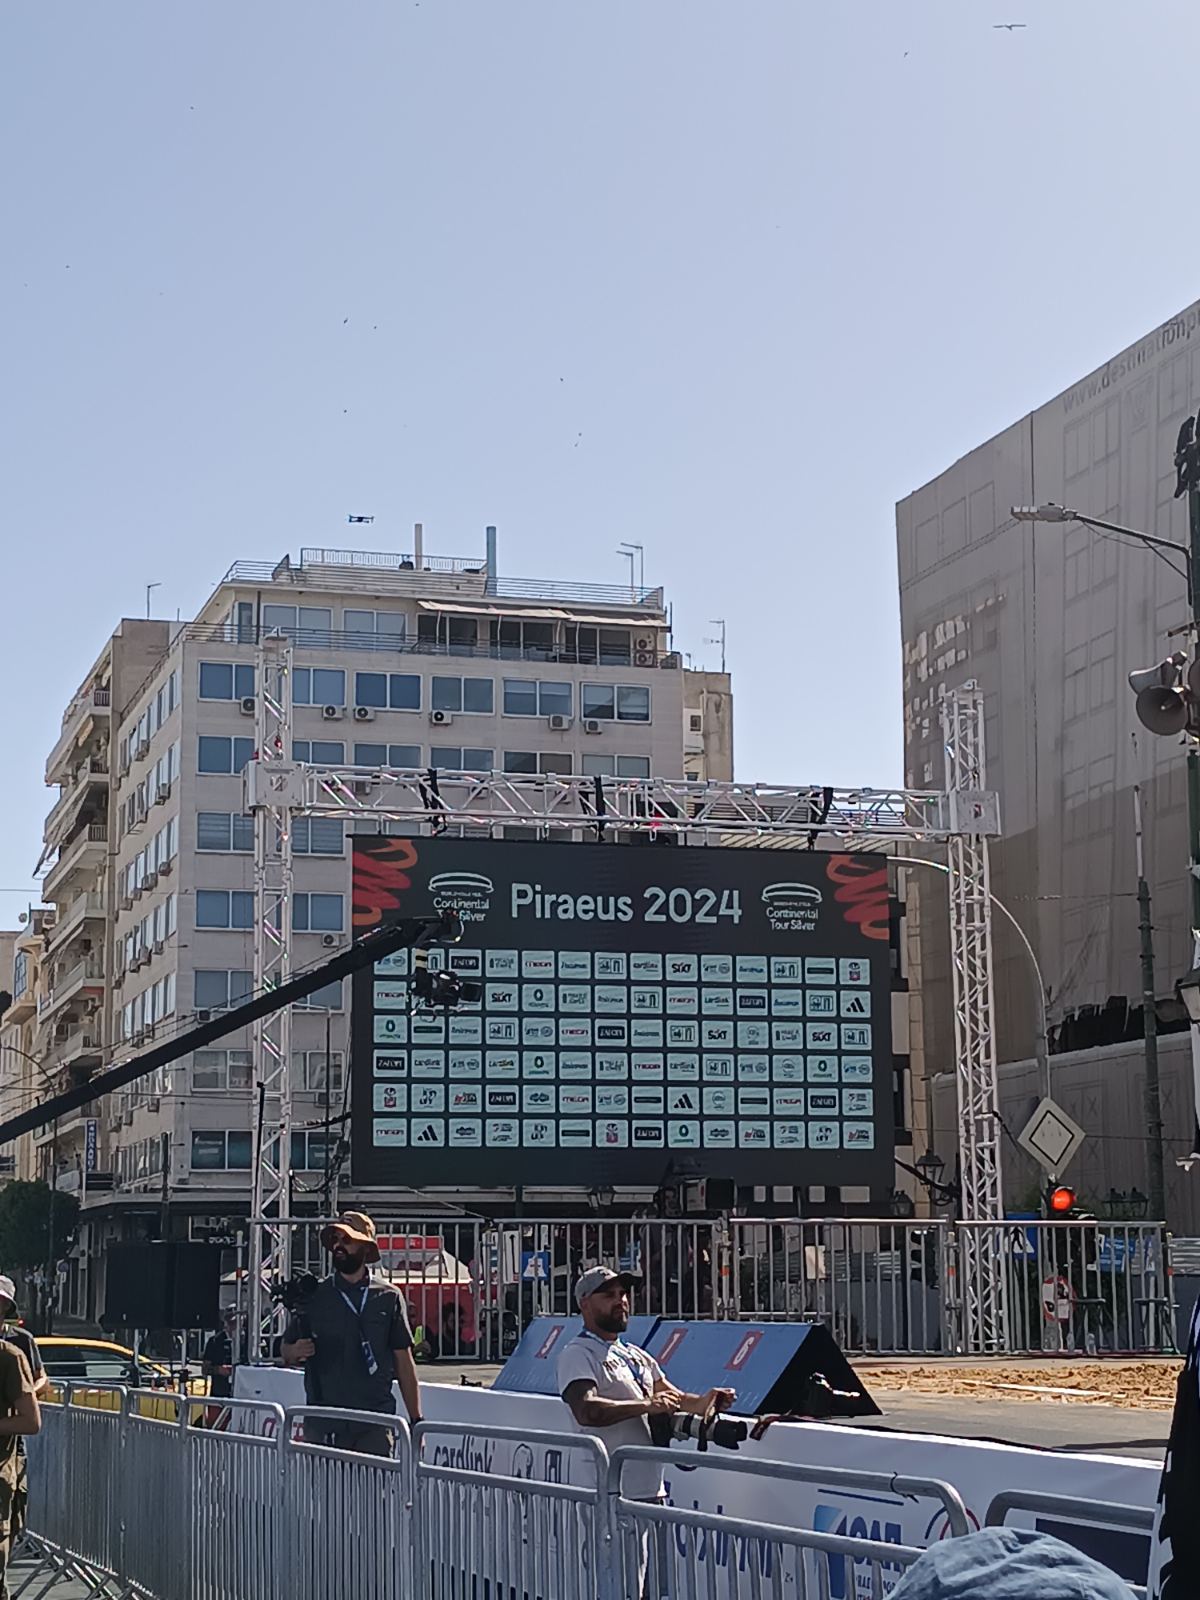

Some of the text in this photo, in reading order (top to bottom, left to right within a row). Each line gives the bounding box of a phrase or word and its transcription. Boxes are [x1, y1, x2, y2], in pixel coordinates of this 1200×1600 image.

[433, 897, 490, 909] Continental
[511, 882, 742, 924] Piraeus 2024
[766, 906, 819, 920] Continental
[769, 918, 816, 931] Tour Silver
[733, 1336, 755, 1365] 6
